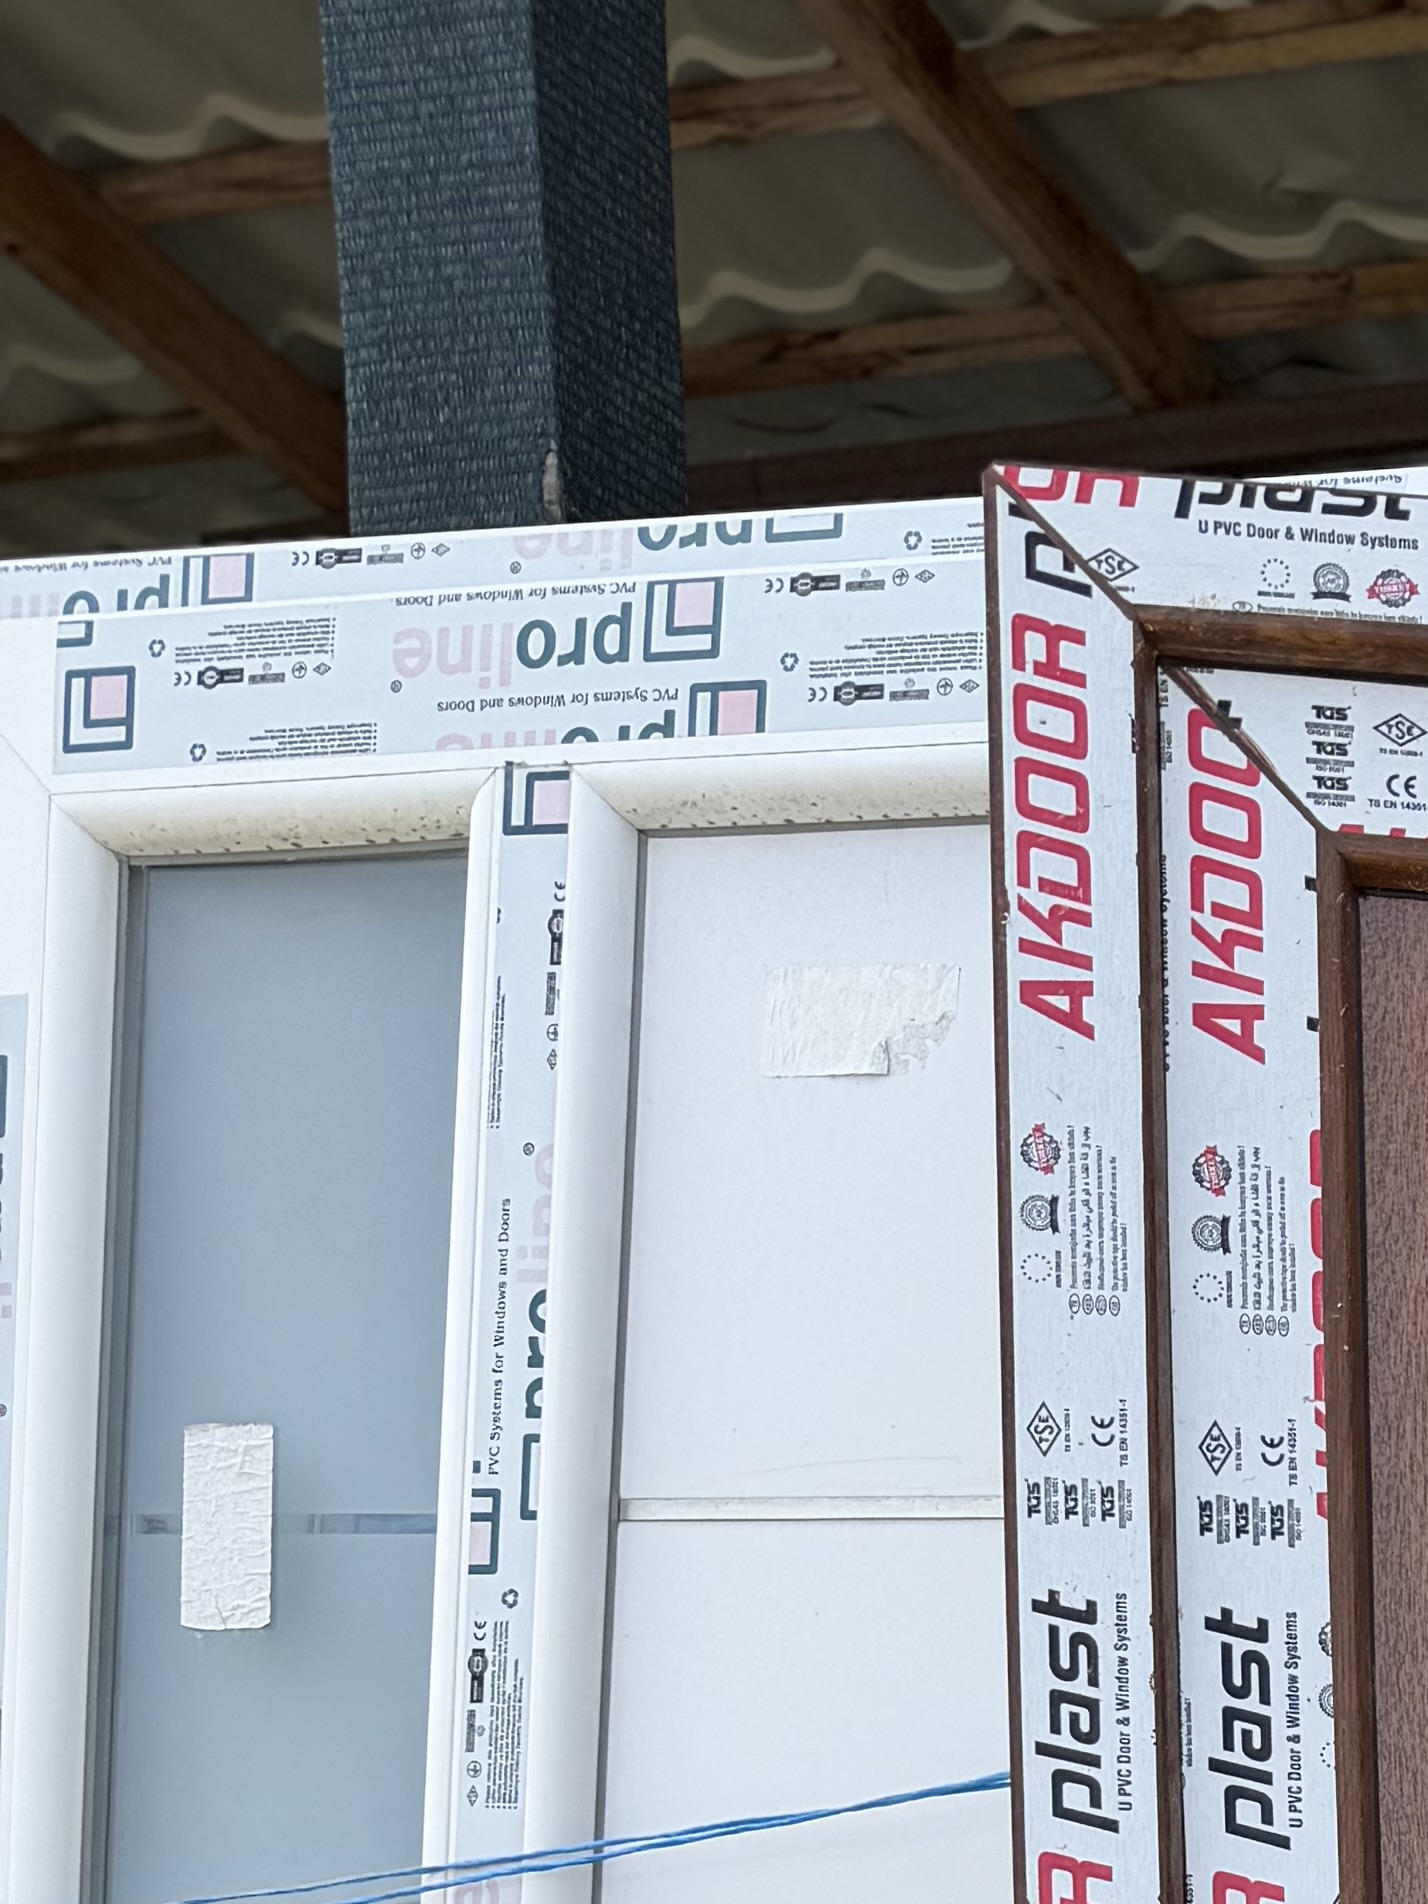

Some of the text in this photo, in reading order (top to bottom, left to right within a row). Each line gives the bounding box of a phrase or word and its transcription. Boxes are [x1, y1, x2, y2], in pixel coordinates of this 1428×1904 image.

[1198, 519, 1419, 551] U PVC Door & Window Systems
[395, 581, 636, 607] PVC Systems for Windows and Doors
[391, 601, 633, 692] proline
[437, 686, 679, 713] PVC Systems for Windows and Doors
[808, 687, 827, 702] CE
[1386, 719, 1415, 740] TSE
[1010, 614, 1094, 1040] AKDOOR
[488, 1198, 511, 1475] PVC Systems for Windows and Doors
[1033, 1414, 1050, 1445] TSE
[1091, 1416, 1115, 1446] CE
[1030, 1588, 1123, 1834] plast
[1113, 1592, 1133, 1811] U PVC Door & Window Systems
[1203, 1606, 1295, 1851] plast
